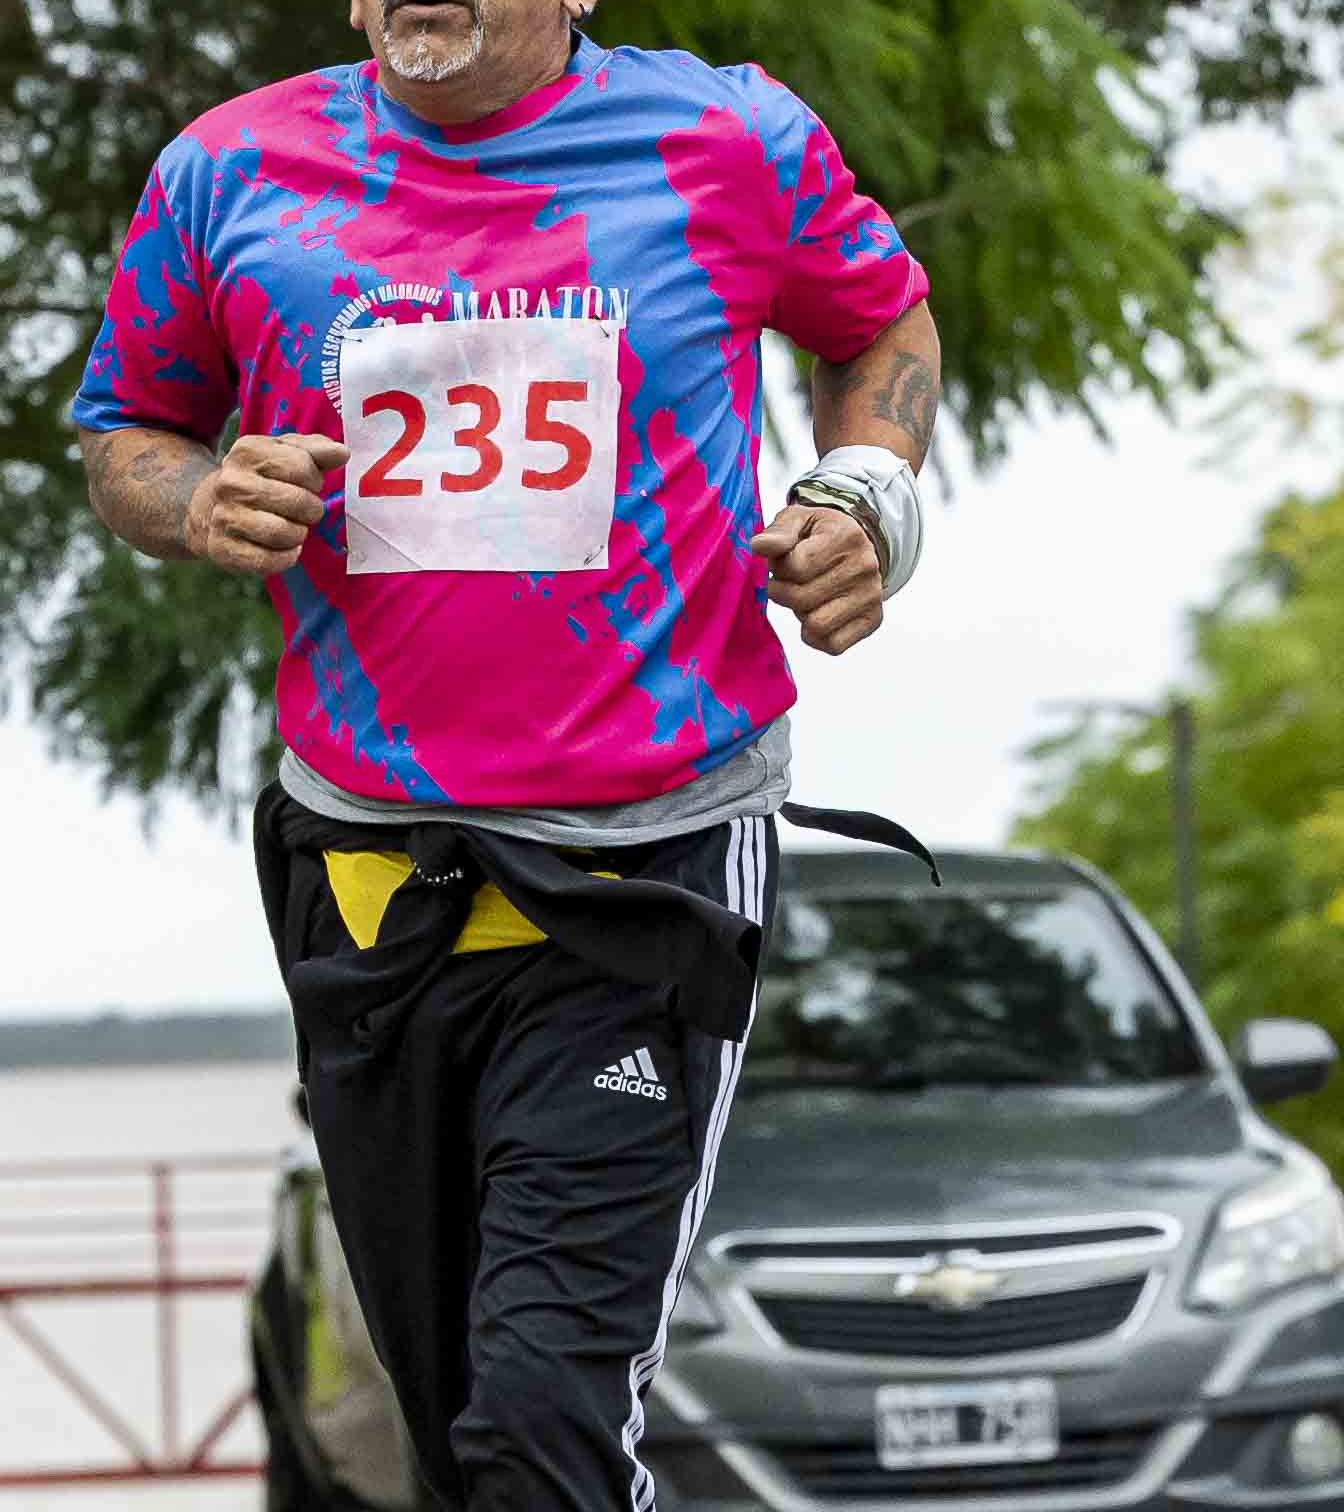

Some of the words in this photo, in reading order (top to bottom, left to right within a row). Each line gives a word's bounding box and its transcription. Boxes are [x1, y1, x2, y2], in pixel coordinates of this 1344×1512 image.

[322, 294, 372, 356] ESCUCHADOS
[368, 289, 378, 304] Y
[378, 283, 443, 305] VALORADOS
[358, 380, 593, 499] 235
[593, 1072, 668, 1101] adidas
